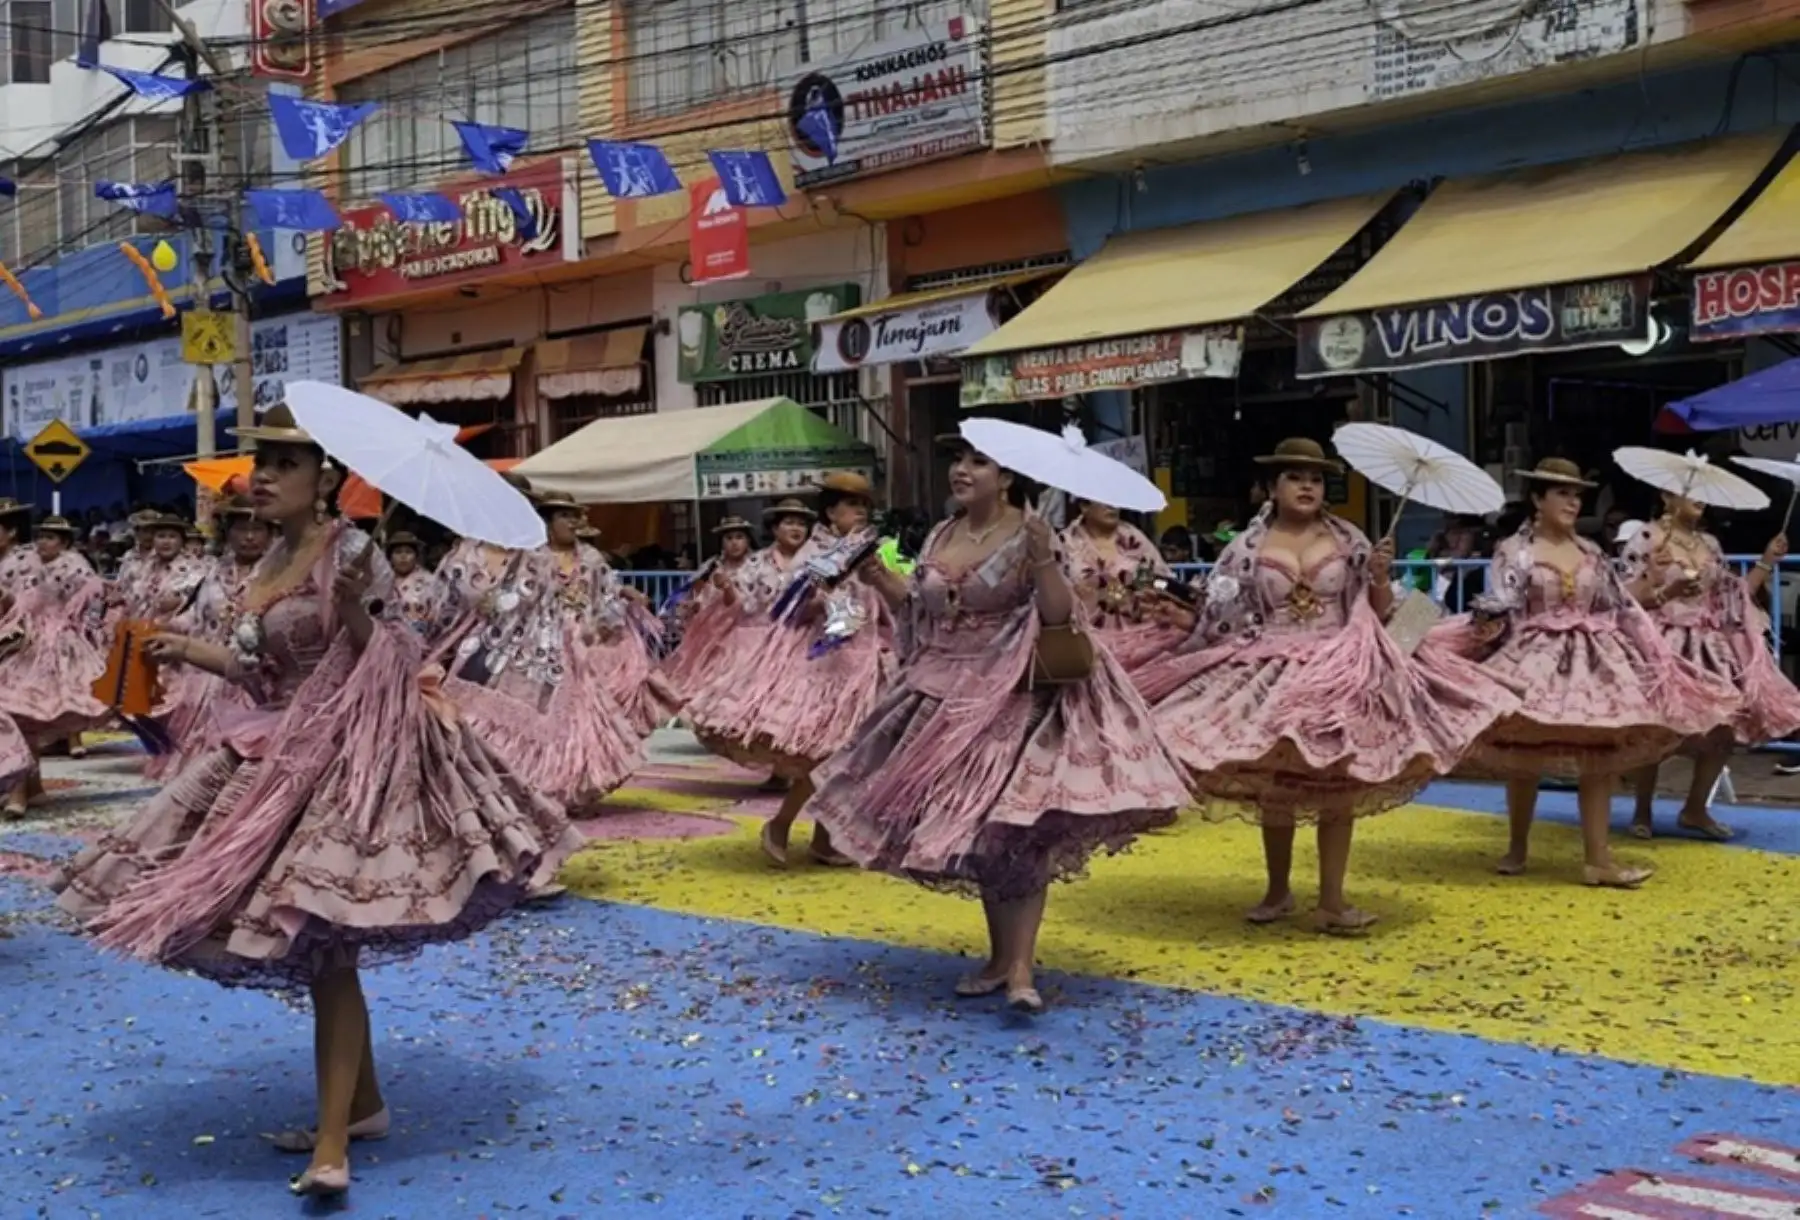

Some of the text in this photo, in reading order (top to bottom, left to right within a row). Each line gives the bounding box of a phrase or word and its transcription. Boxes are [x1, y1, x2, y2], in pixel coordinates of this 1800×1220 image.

[855, 43, 948, 82] KANKACHOS
[847, 64, 967, 120] TINAJANI
[873, 312, 961, 354] Tinajani
[1372, 288, 1554, 358] VINOS
[728, 350, 799, 372] CREMA
